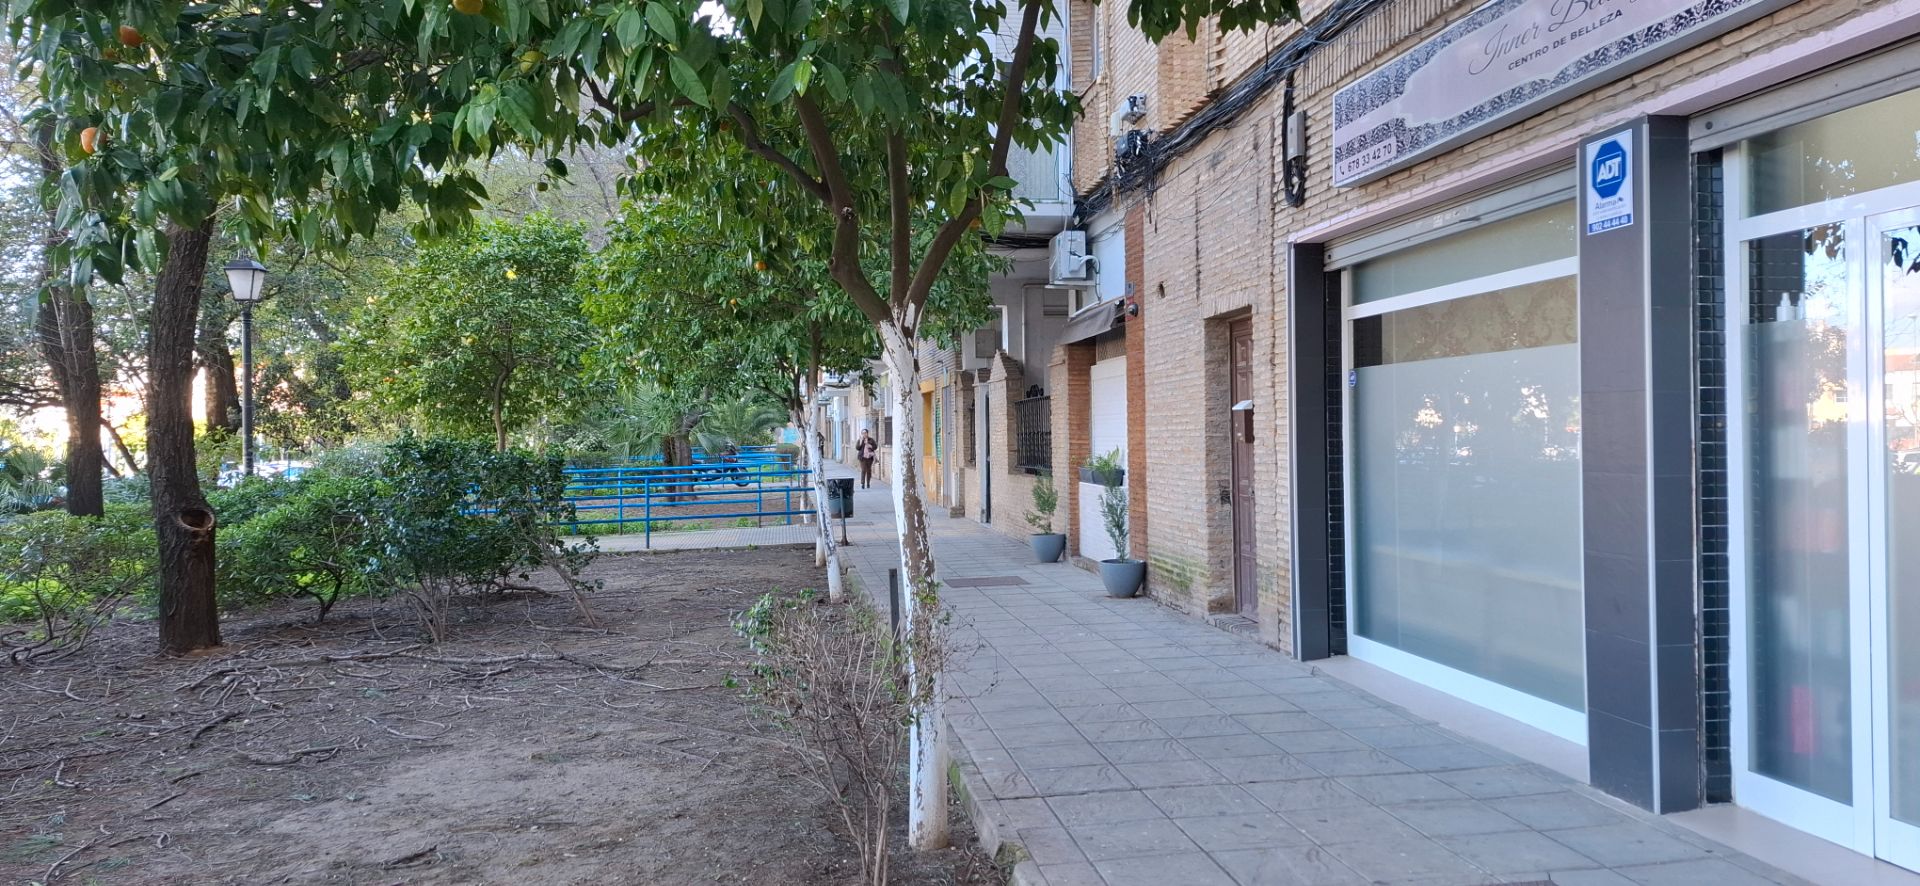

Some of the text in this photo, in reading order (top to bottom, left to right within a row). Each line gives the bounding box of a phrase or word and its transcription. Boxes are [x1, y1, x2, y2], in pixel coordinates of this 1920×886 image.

[1469, 23, 1540, 75] Inner
[1508, 45, 1549, 71] CENTRO
[1552, 38, 1567, 50] DE
[1570, 9, 1623, 40] BELLEZA
[1347, 143, 1392, 172] 678 33 42 70
[1597, 156, 1622, 183] ADT
